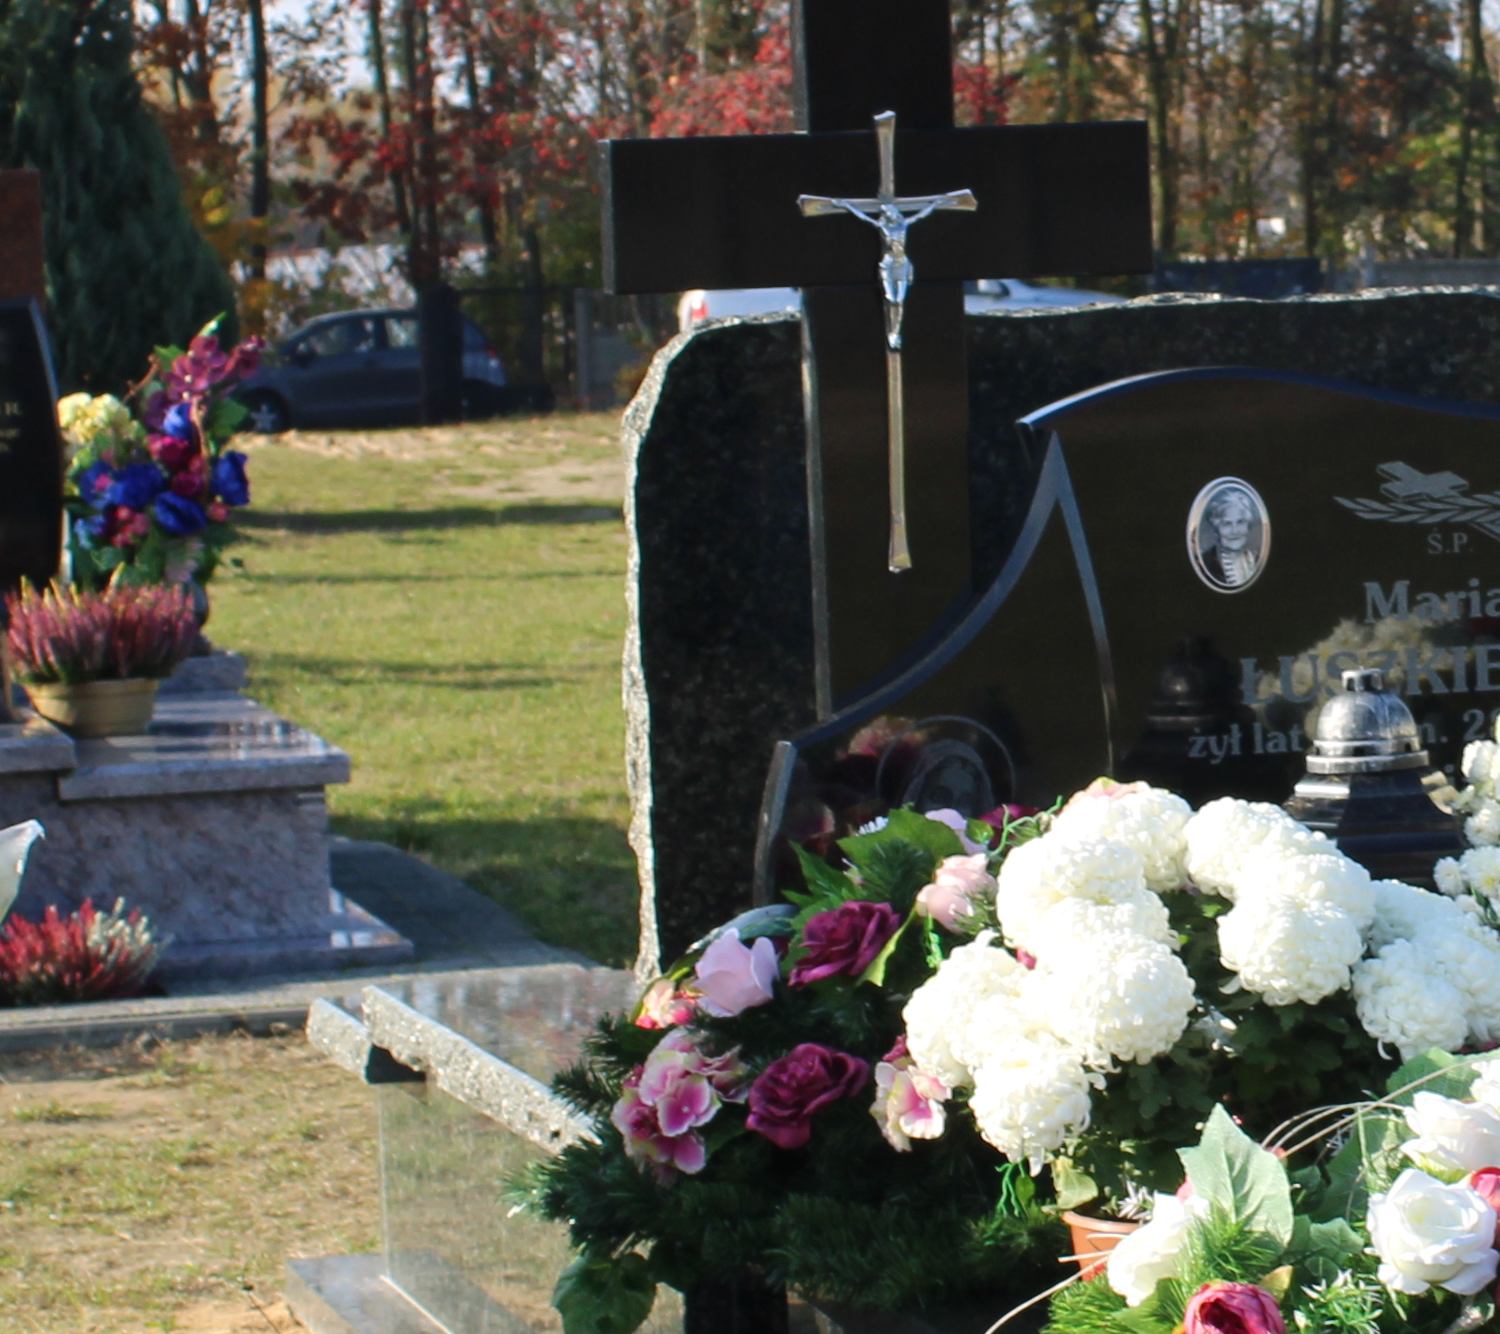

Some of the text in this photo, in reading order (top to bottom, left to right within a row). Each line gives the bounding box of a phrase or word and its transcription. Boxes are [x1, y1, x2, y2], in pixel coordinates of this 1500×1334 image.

[1427, 528, 1475, 554] Ś.P.
[1187, 721, 1242, 764] żył
[1253, 722, 1304, 754] lat
